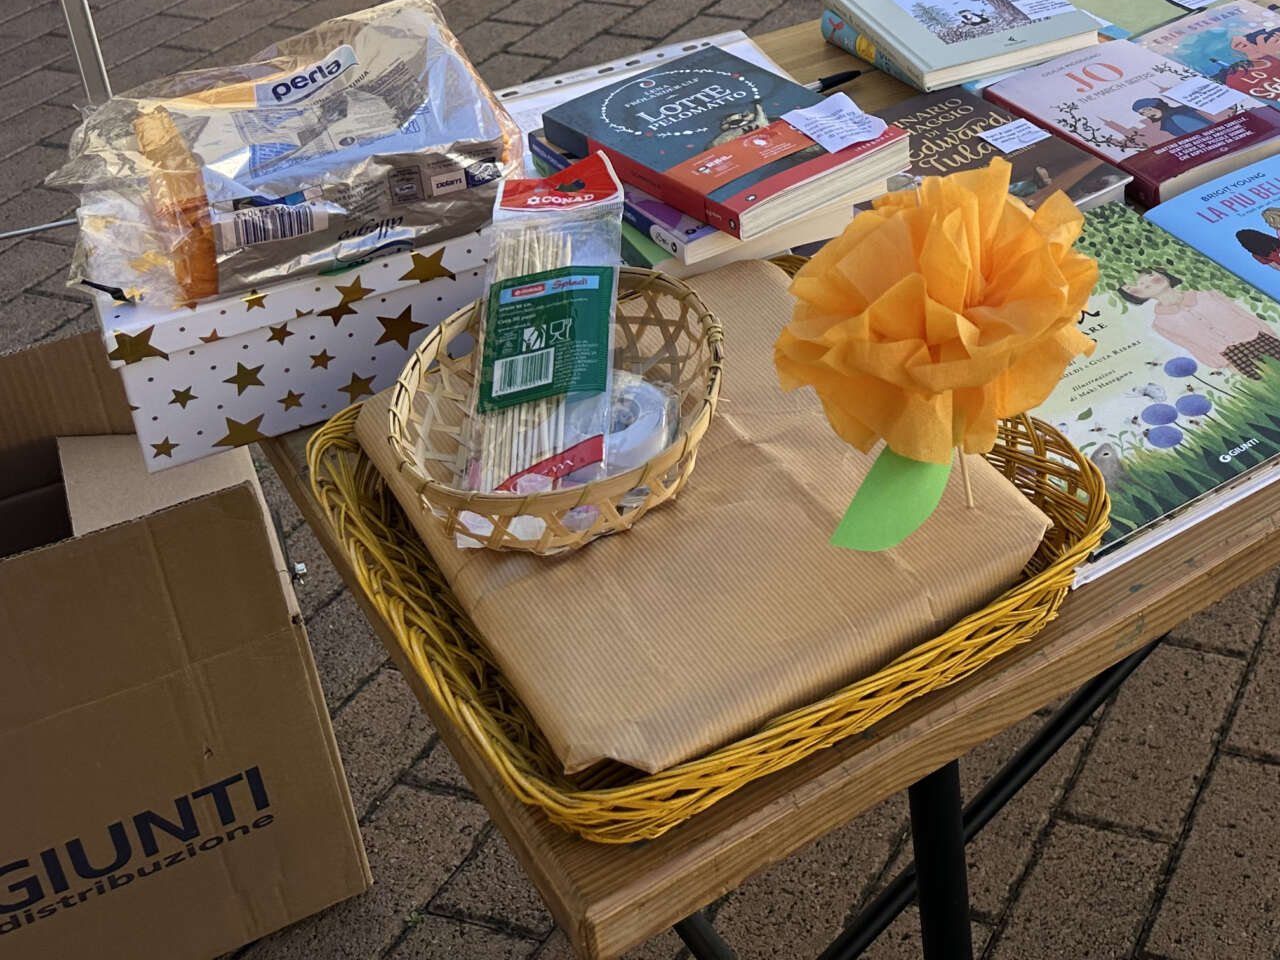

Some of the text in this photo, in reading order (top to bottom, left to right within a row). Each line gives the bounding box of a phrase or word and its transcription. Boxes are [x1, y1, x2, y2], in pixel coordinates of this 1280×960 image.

[1152, 8, 1244, 45] ERIN STEWART
[271, 58, 342, 103] perla
[1064, 62, 1124, 92] JO
[1240, 70, 1268, 84] LO
[635, 84, 731, 123] LOTTE
[647, 91, 747, 131] PELOMATTO
[892, 98, 962, 128] INARIO
[907, 105, 974, 136] IAGGIO
[925, 129, 940, 138] DI
[918, 142, 998, 172] Tula
[541, 193, 596, 205] CONAD
[1200, 171, 1267, 202] BRIGIT YOUNG
[1196, 205, 1230, 224] LA
[1228, 438, 1260, 457] GIUNTI
[0, 765, 271, 915] GIUNTI
[0, 812, 275, 936] distribuzione
